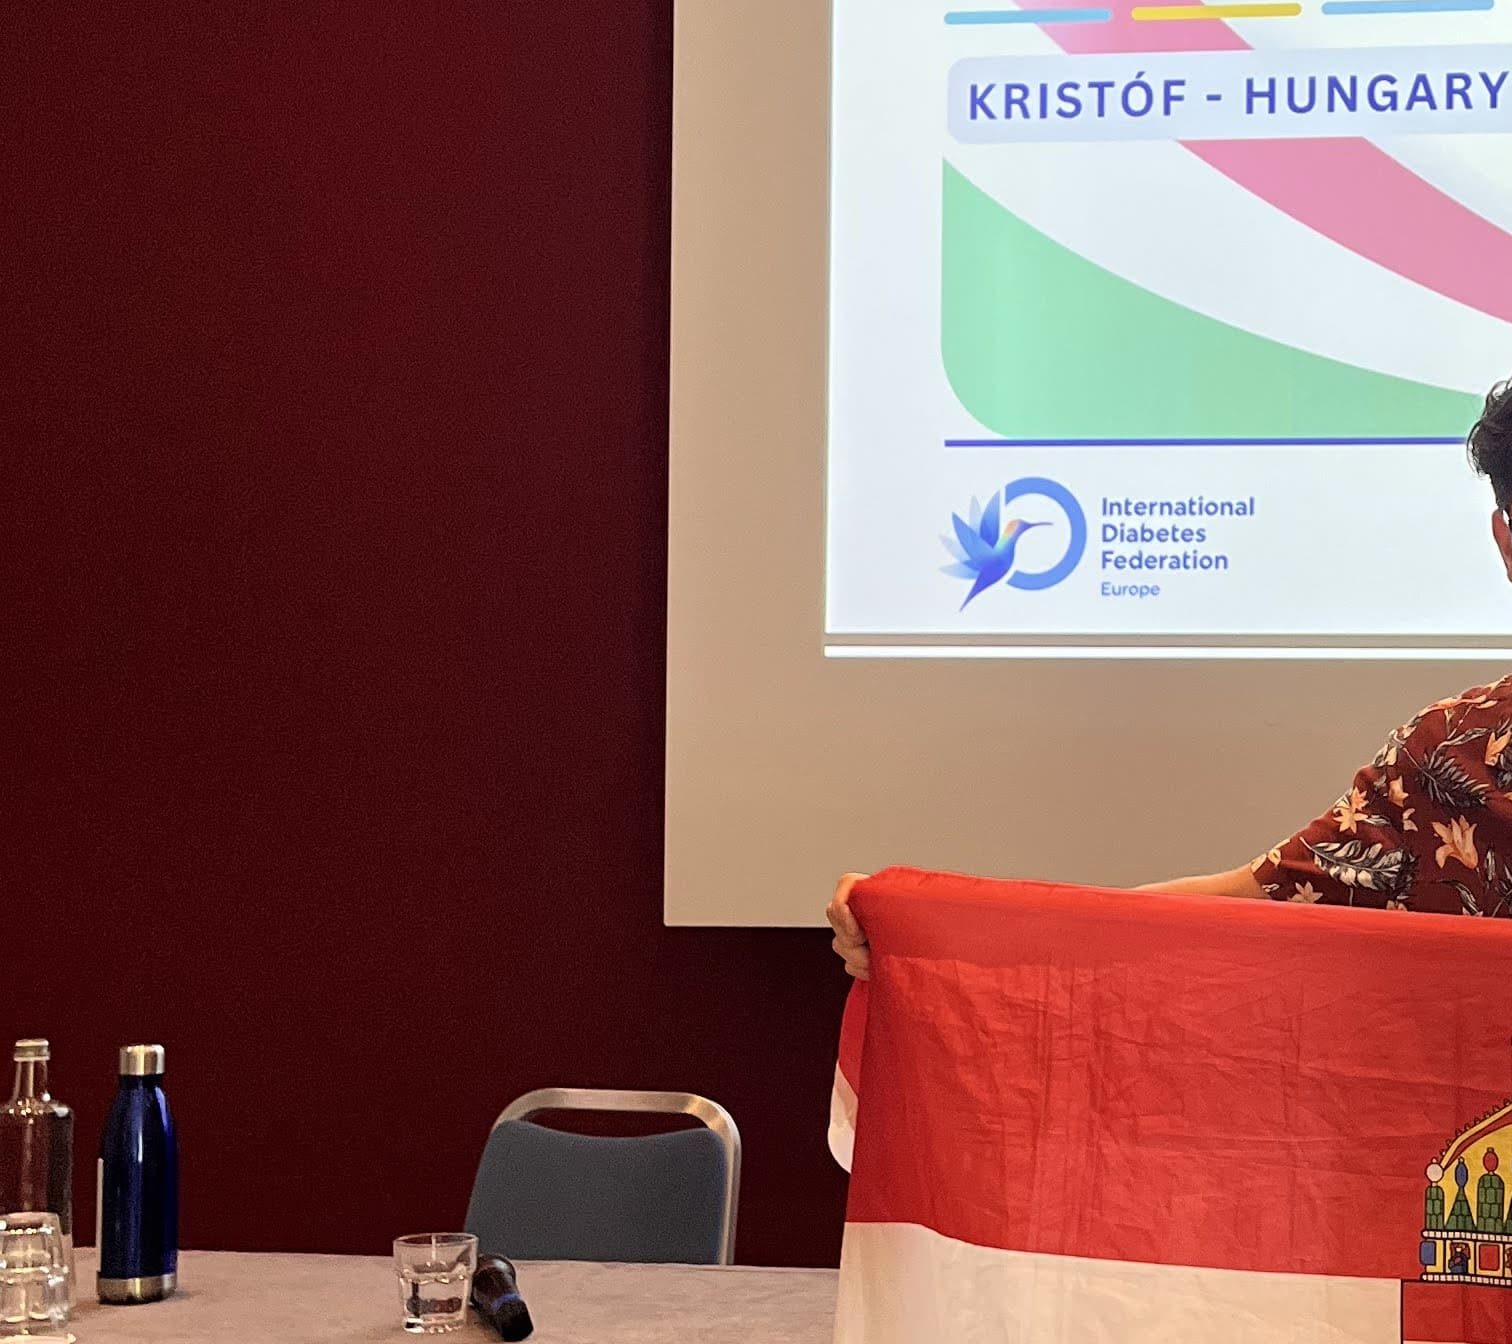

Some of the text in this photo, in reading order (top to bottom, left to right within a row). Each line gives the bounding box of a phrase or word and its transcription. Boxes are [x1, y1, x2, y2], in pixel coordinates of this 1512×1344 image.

[969, 71, 1188, 120] KRISTÓF
[1244, 70, 1511, 115] HUNGARY
[1102, 496, 1255, 517] International
[1101, 523, 1207, 543] Diabetes
[1101, 550, 1229, 570] Federation
[1101, 581, 1161, 598] Europe
